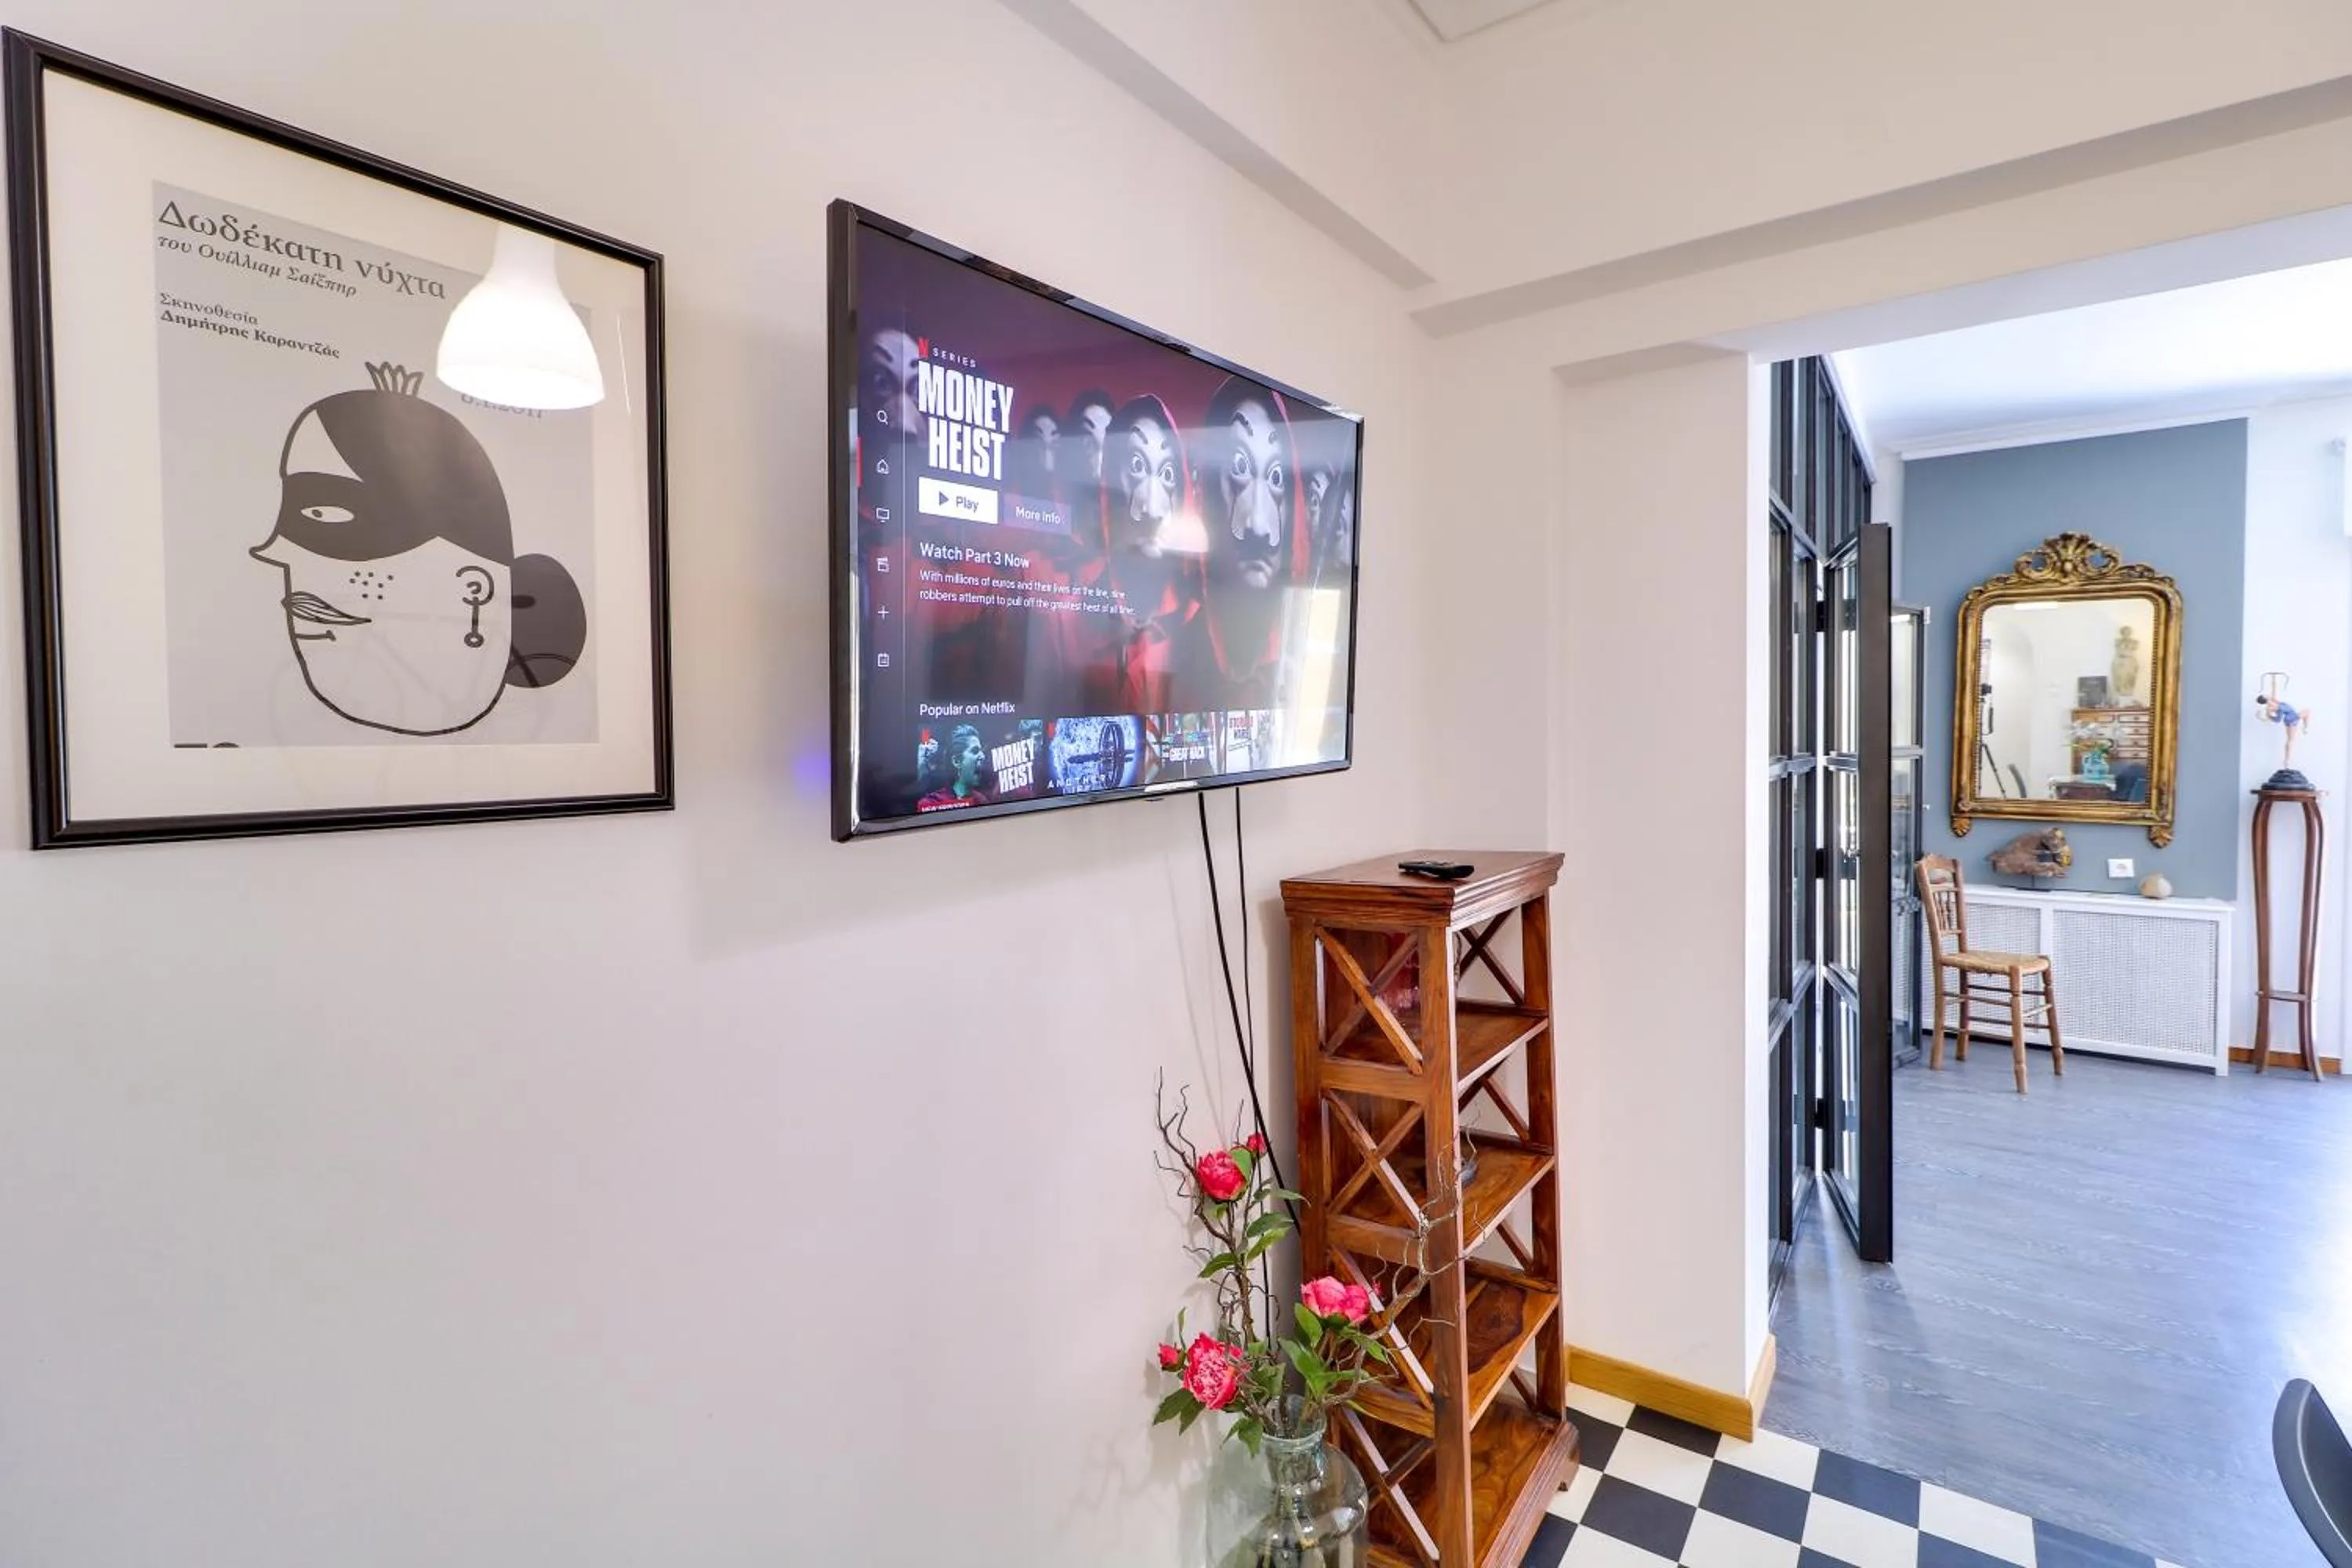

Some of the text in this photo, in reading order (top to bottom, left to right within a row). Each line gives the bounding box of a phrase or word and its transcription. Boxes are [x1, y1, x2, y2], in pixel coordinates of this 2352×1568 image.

[158, 200, 445, 299] Δωδέκατη νύχτα
[158, 236, 191, 253] του
[198, 244, 281, 278] Ουίλλιαμ
[160, 292, 258, 325] Σκηνοθεσία
[160, 310, 339, 358] Δημήτρης Καραντζάς
[933, 347, 976, 368] SERIES
[918, 360, 1014, 434] MONEY
[928, 416, 1005, 480] HEIST
[956, 495, 979, 514] Play
[1015, 506, 1061, 524] More Info
[920, 542, 1029, 568] Watch Part 3 Now
[920, 569, 943, 583] With
[945, 573, 979, 586] millions
[981, 576, 990, 586] of
[992, 579, 1015, 589] euros
[1017, 581, 1033, 590] and
[920, 589, 956, 601] robbers
[959, 593, 995, 605] attempt
[996, 594, 1006, 604] to
[1007, 596, 1022, 607] pull
[1023, 597, 1034, 608] off
[1036, 597, 1049, 608] the
[920, 702, 1015, 718] Popular on Netflix
[991, 737, 1035, 772] MONEY
[998, 761, 1034, 794] HEIST
